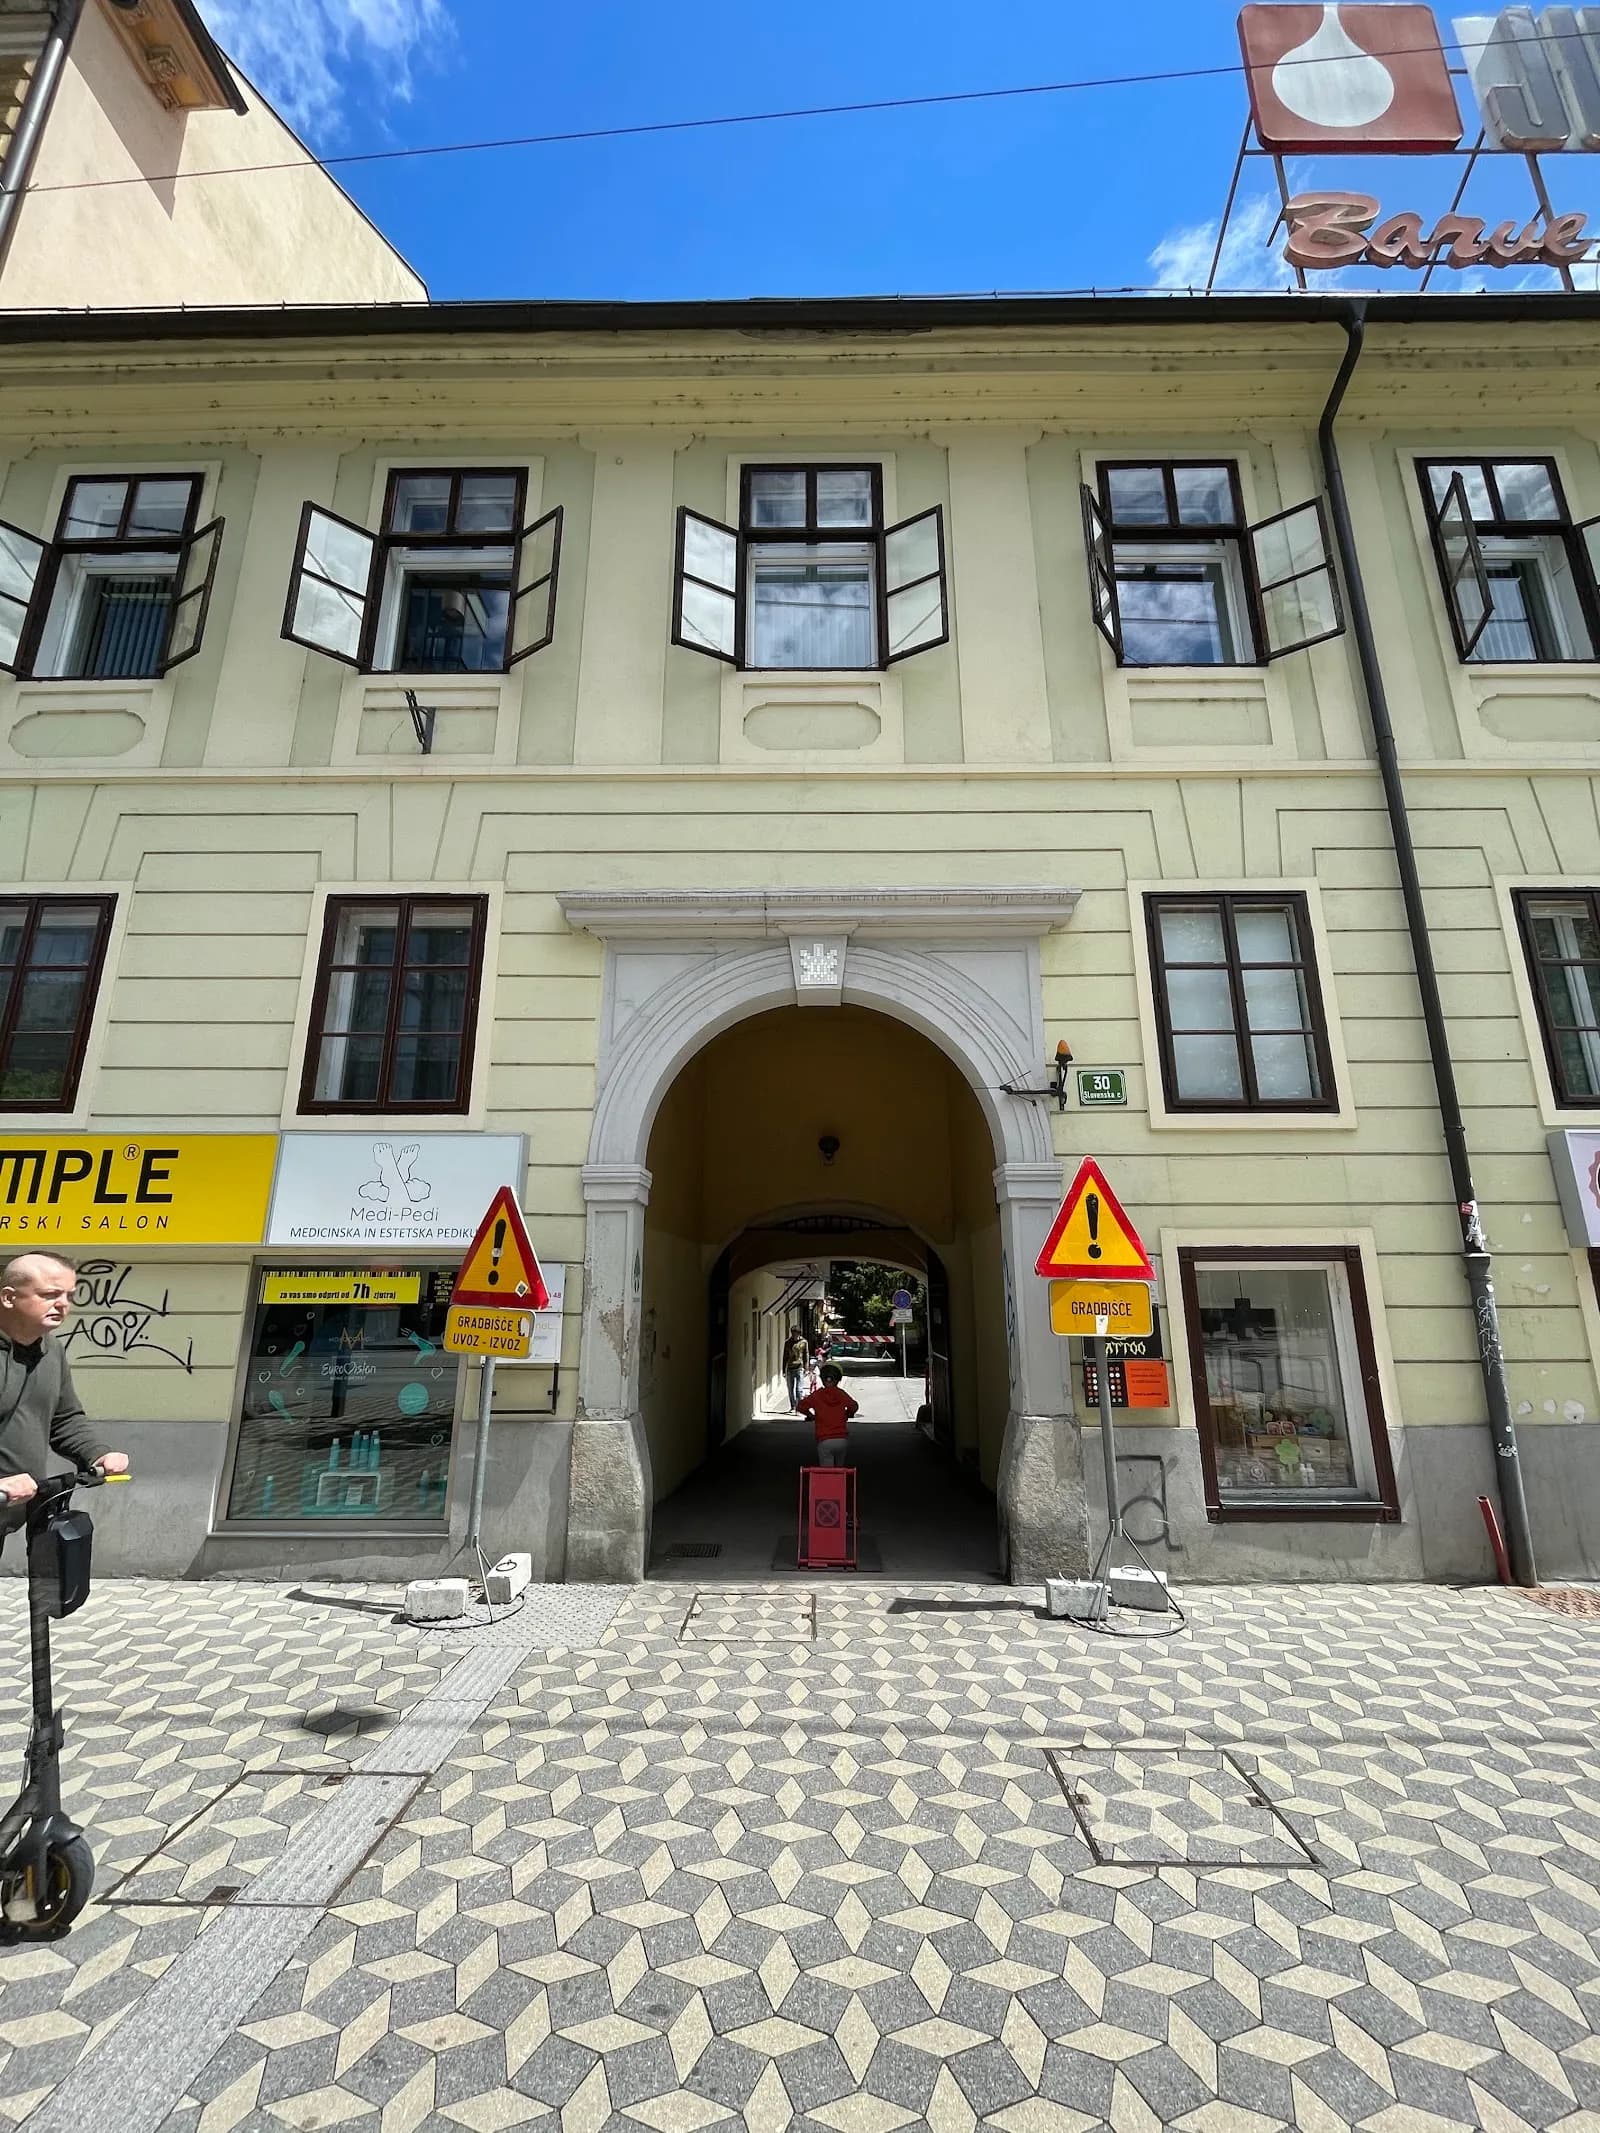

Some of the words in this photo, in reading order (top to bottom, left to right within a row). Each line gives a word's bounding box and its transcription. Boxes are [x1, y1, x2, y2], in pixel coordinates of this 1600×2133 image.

[1093, 1075, 1110, 1090] 30
[81, 1215, 169, 1229] SALON
[350, 1207, 439, 1222] Medi-Pedi
[290, 1227, 360, 1239] MEDICINSKA
[363, 1228, 377, 1239] IN
[379, 1228, 433, 1239] ESTETSKA
[318, 1291, 340, 1300] odprti
[340, 1291, 350, 1299] od
[352, 1283, 371, 1299] 7h
[453, 1333, 479, 1347] UVOZ
[489, 1336, 521, 1351] IZVOZ
[1105, 1341, 1147, 1356] ATTOO
